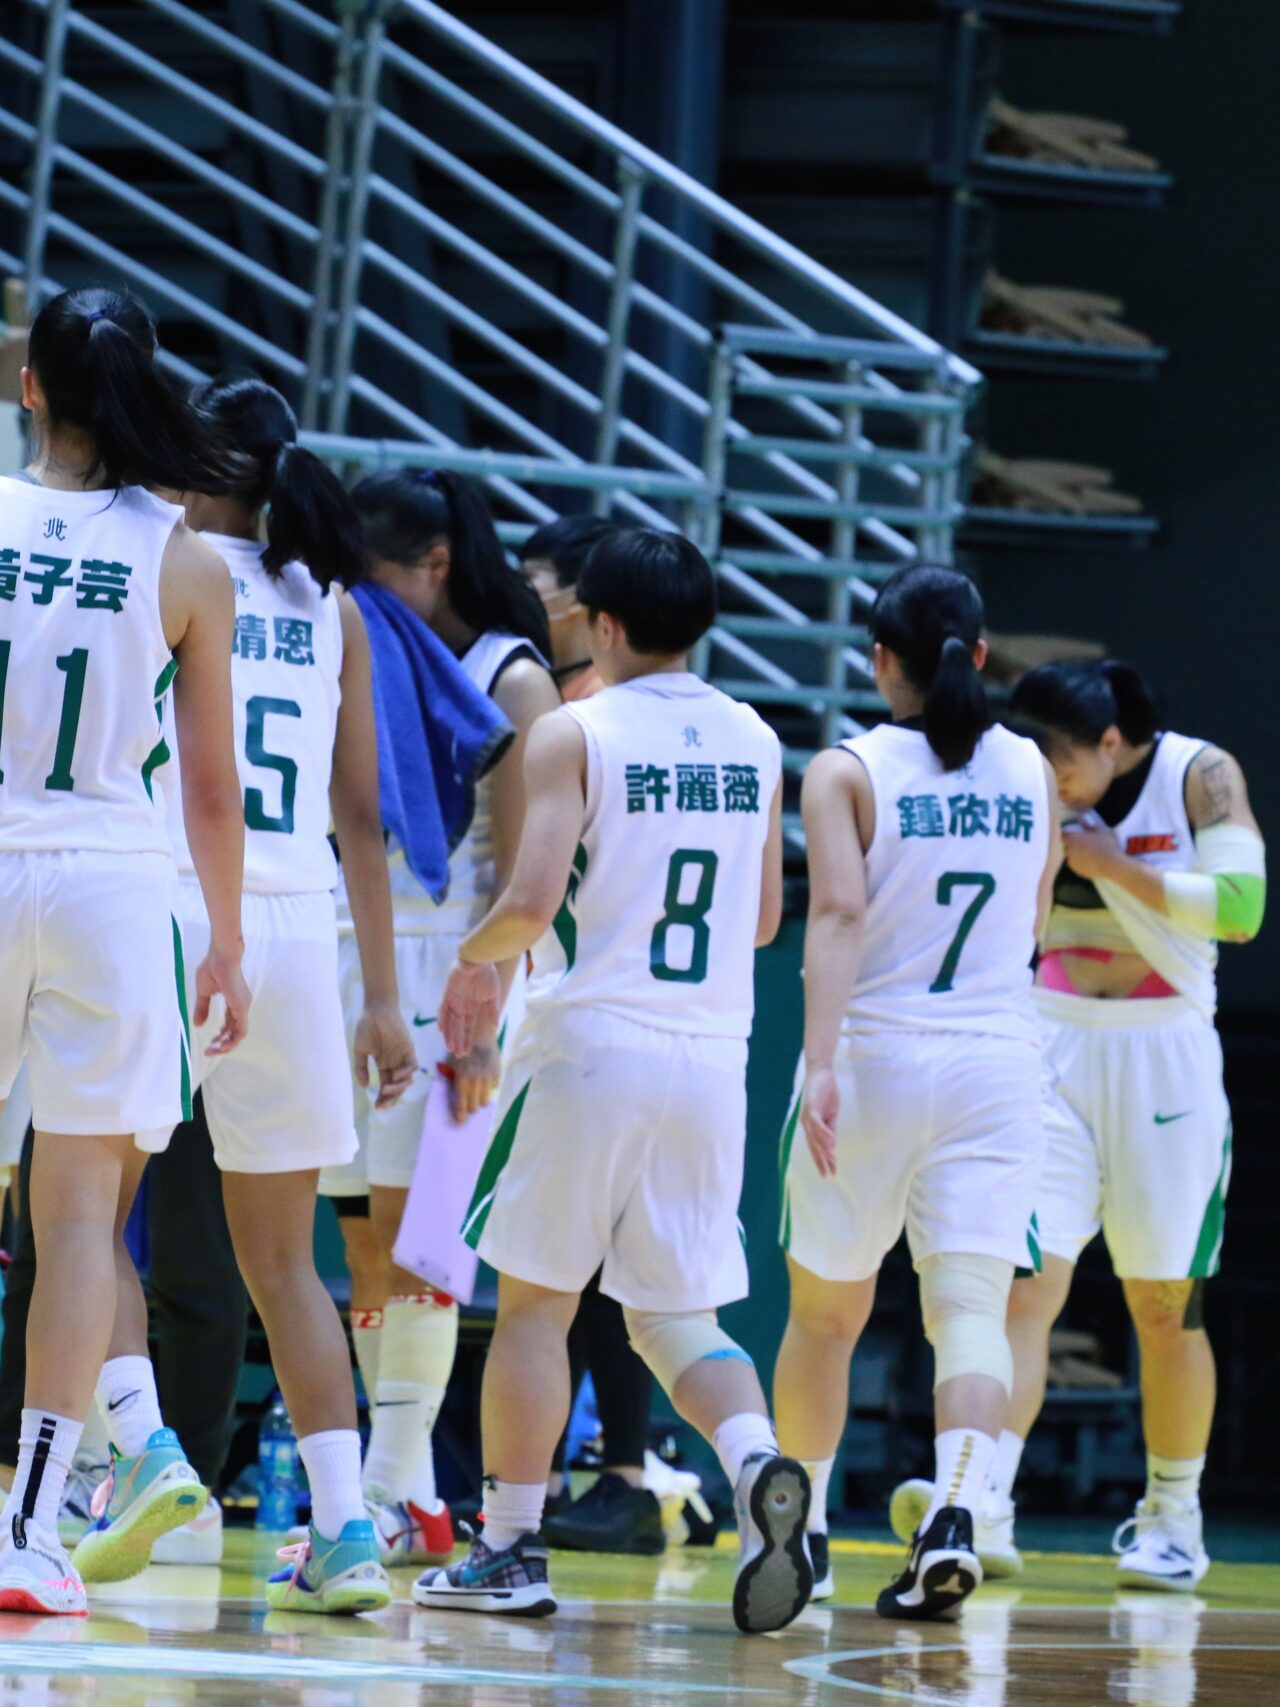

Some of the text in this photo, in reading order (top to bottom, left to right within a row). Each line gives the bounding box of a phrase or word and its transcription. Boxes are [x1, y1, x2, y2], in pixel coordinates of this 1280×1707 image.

[244, 695, 301, 834] 5
[625, 763, 760, 814] 許麗薇
[649, 848, 719, 984] 8
[928, 871, 996, 994] 7
